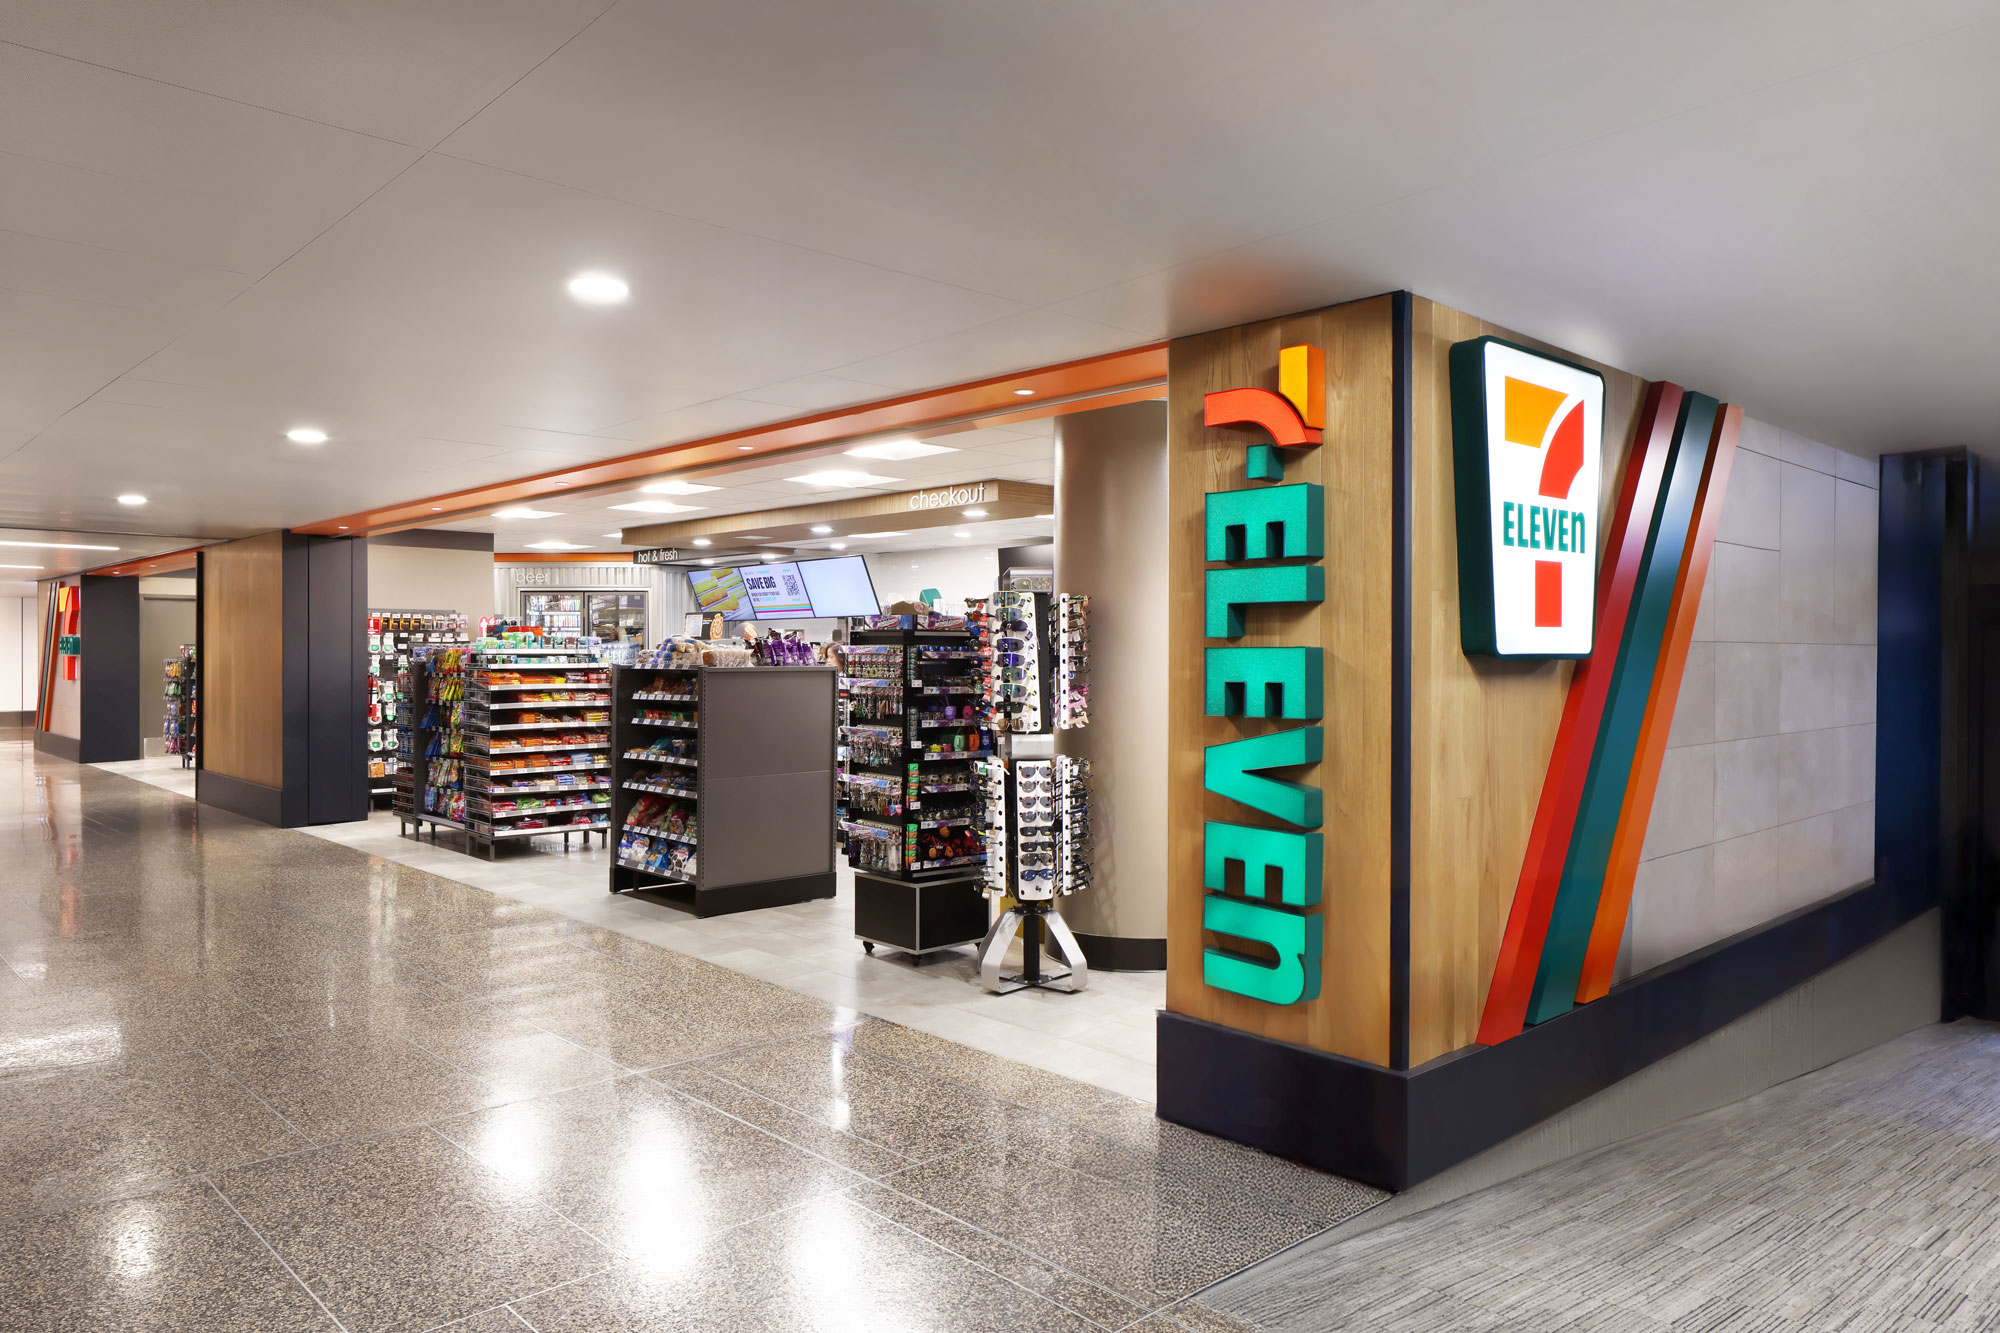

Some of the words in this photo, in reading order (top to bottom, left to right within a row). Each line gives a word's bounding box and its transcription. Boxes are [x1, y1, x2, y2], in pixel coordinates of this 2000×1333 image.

[910, 482, 986, 509] checkout
[1504, 375, 1584, 627] 7
[638, 551, 650, 563] hot
[652, 551, 658, 562] &
[659, 549, 678, 561] fresh
[515, 569, 549, 583] beer
[746, 577, 765, 590] SAVE
[763, 576, 777, 589] BIG
